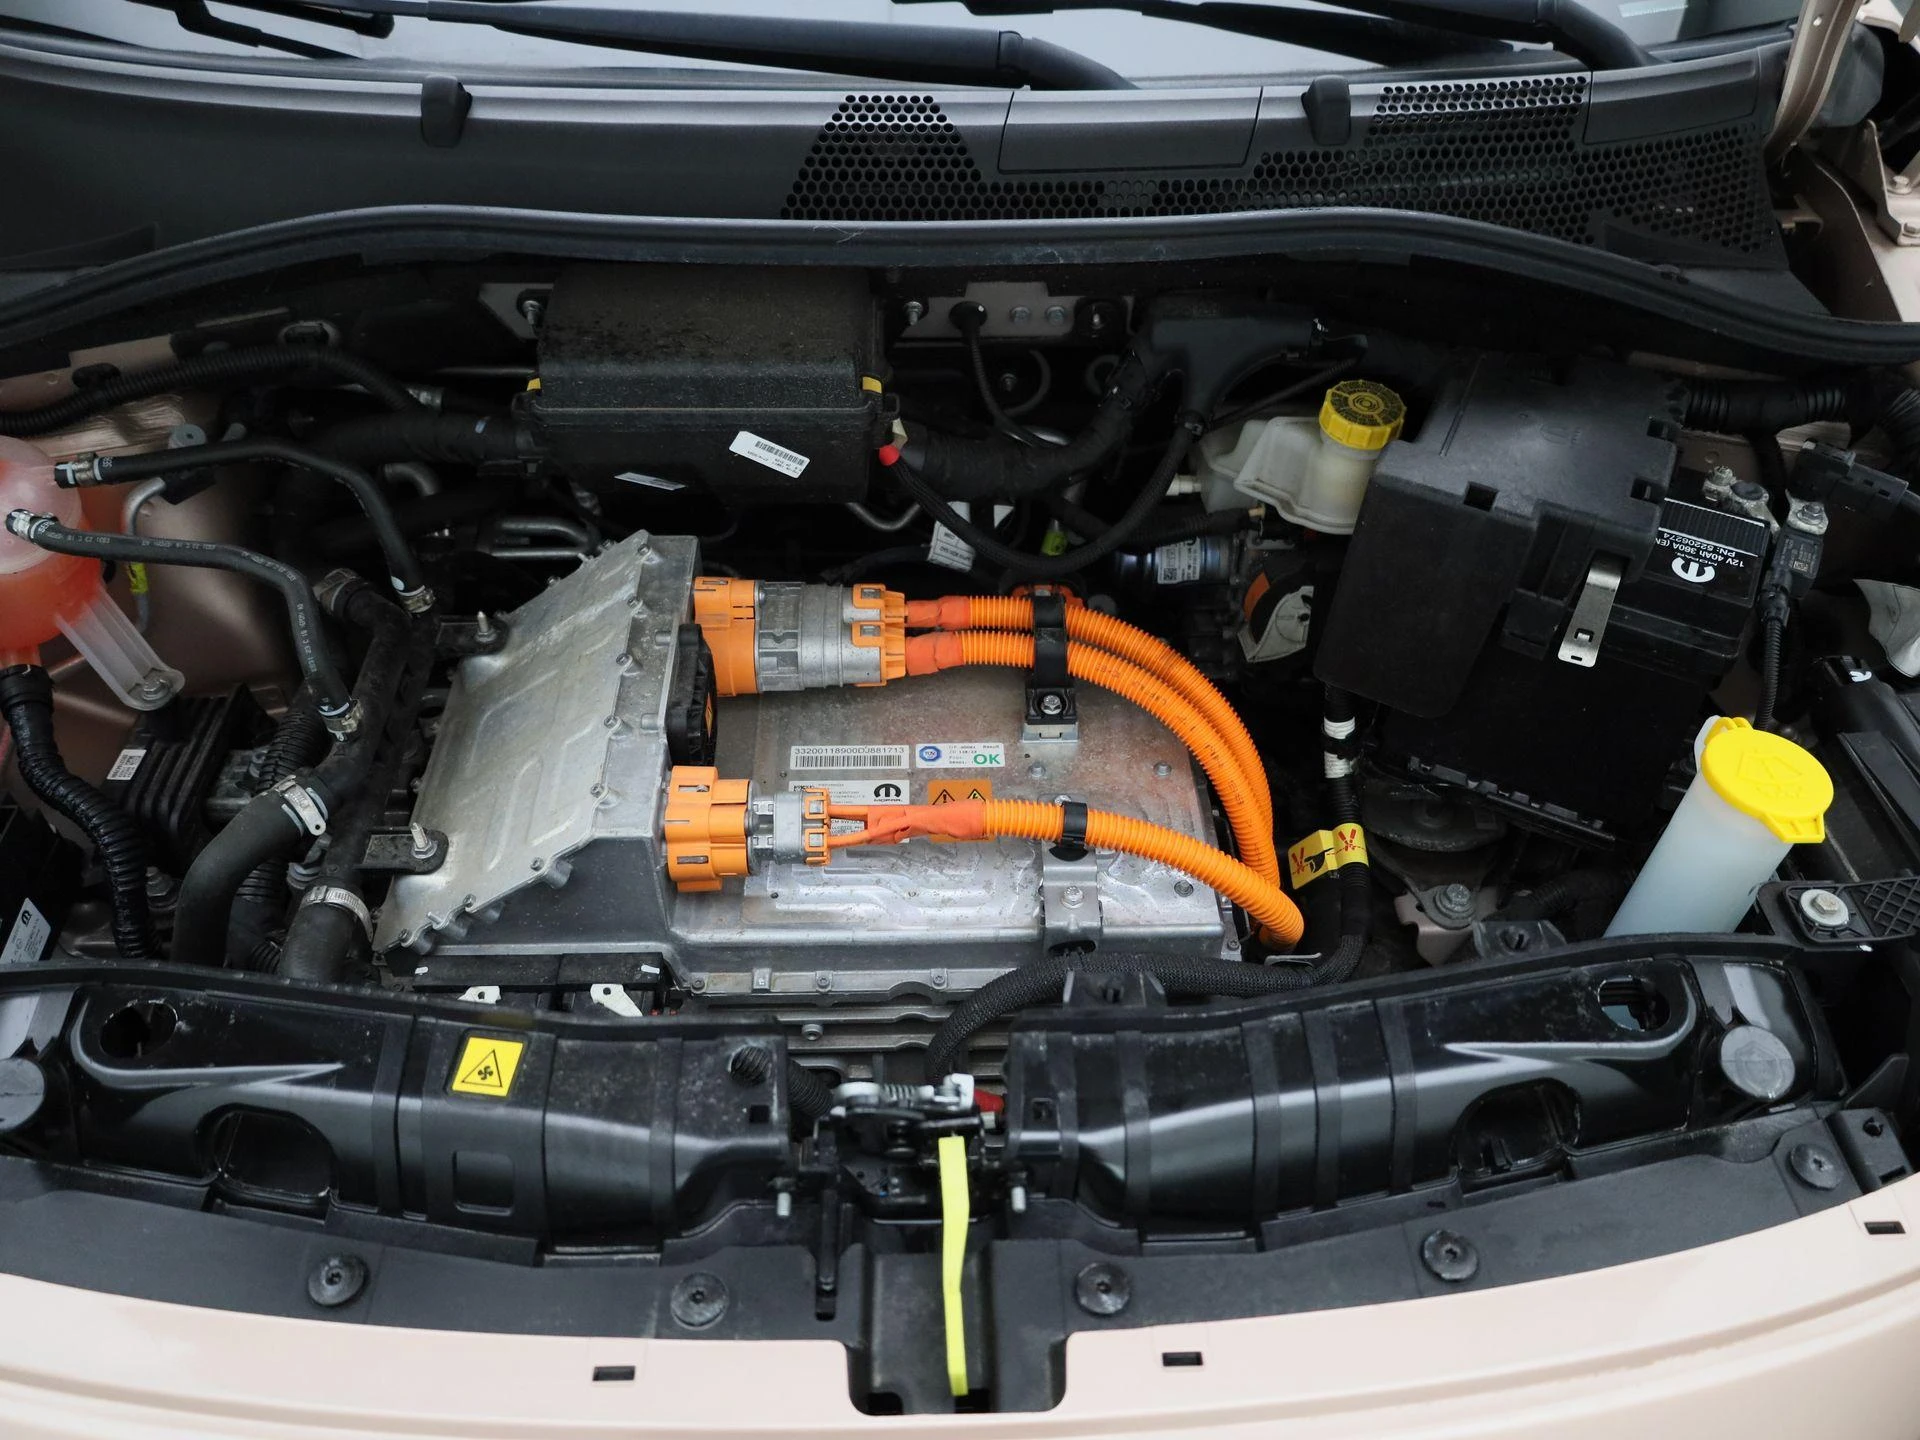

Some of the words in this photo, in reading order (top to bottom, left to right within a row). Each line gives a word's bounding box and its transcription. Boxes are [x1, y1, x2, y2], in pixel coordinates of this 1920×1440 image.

[1663, 532, 1714, 551] 52206274
[1673, 543, 1697, 555] 360A
[1716, 547, 1736, 557] PN:
[1699, 550, 1724, 562] 40Ah
[1726, 558, 1744, 568] 12V
[974, 754, 1001, 764] OK
